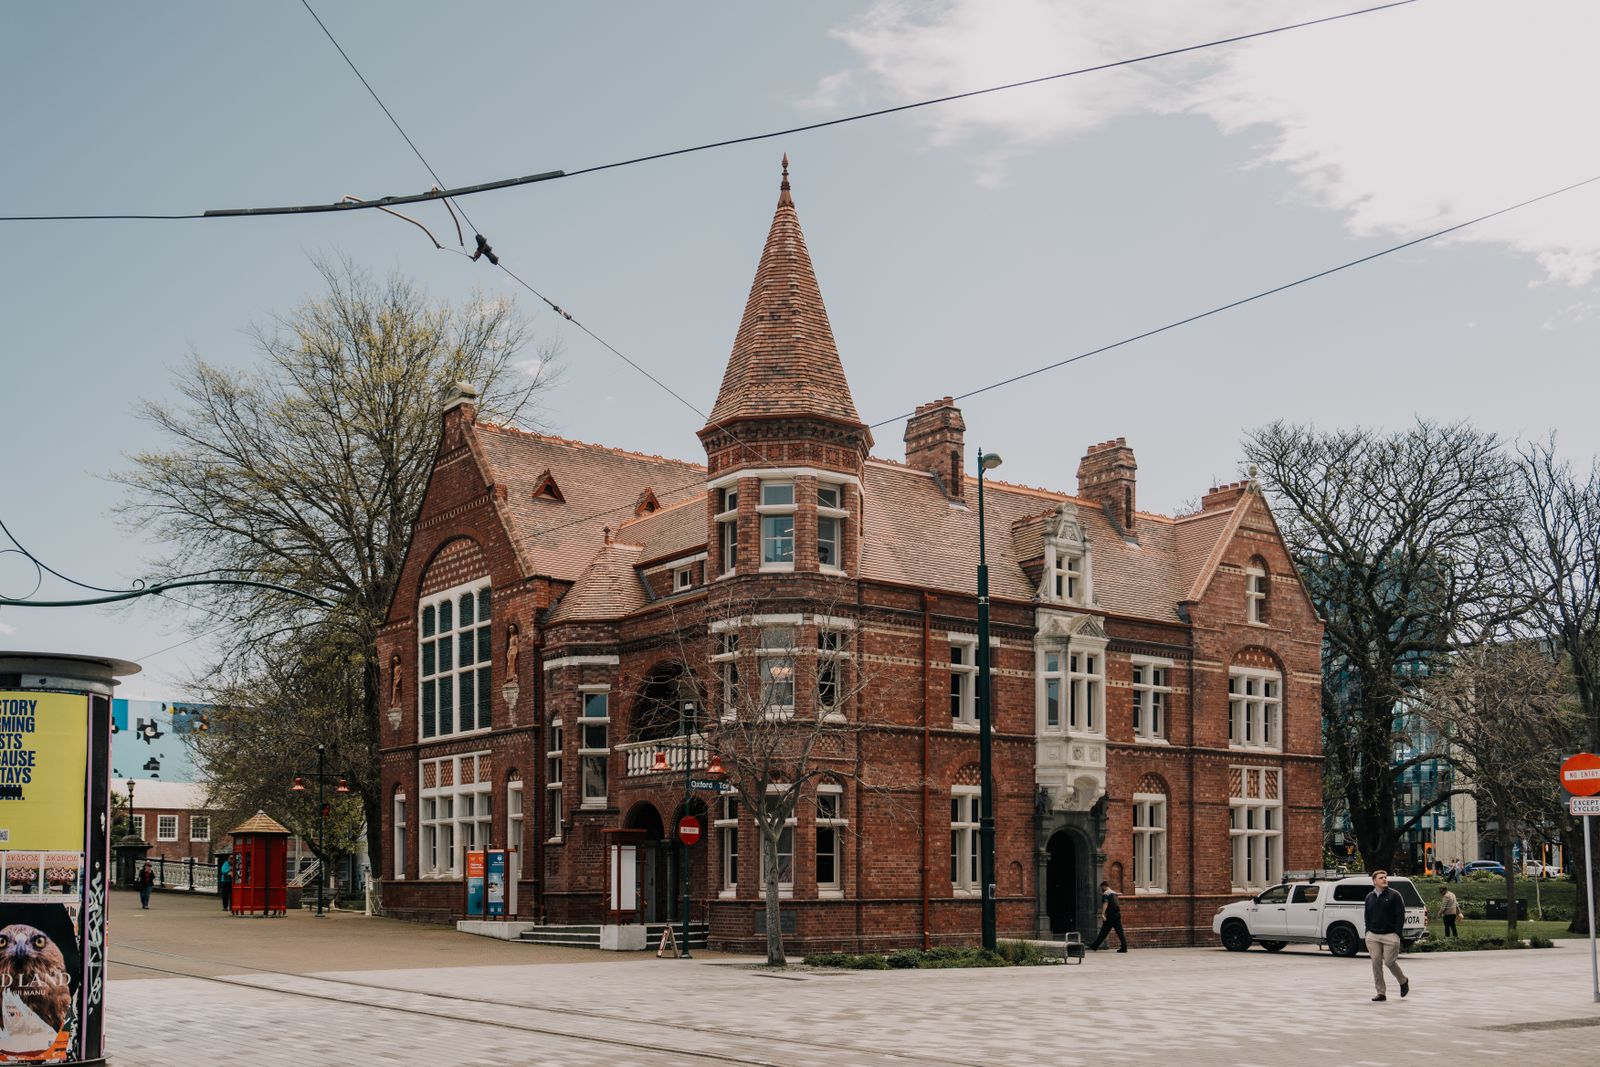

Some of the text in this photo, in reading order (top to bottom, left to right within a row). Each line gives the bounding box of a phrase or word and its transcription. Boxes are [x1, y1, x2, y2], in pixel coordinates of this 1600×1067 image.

[0, 700, 37, 716] TORY
[0, 717, 35, 733] MING
[0, 750, 36, 767] AUSE
[691, 780, 713, 789] Oxford
[18, 972, 72, 988] LAND
